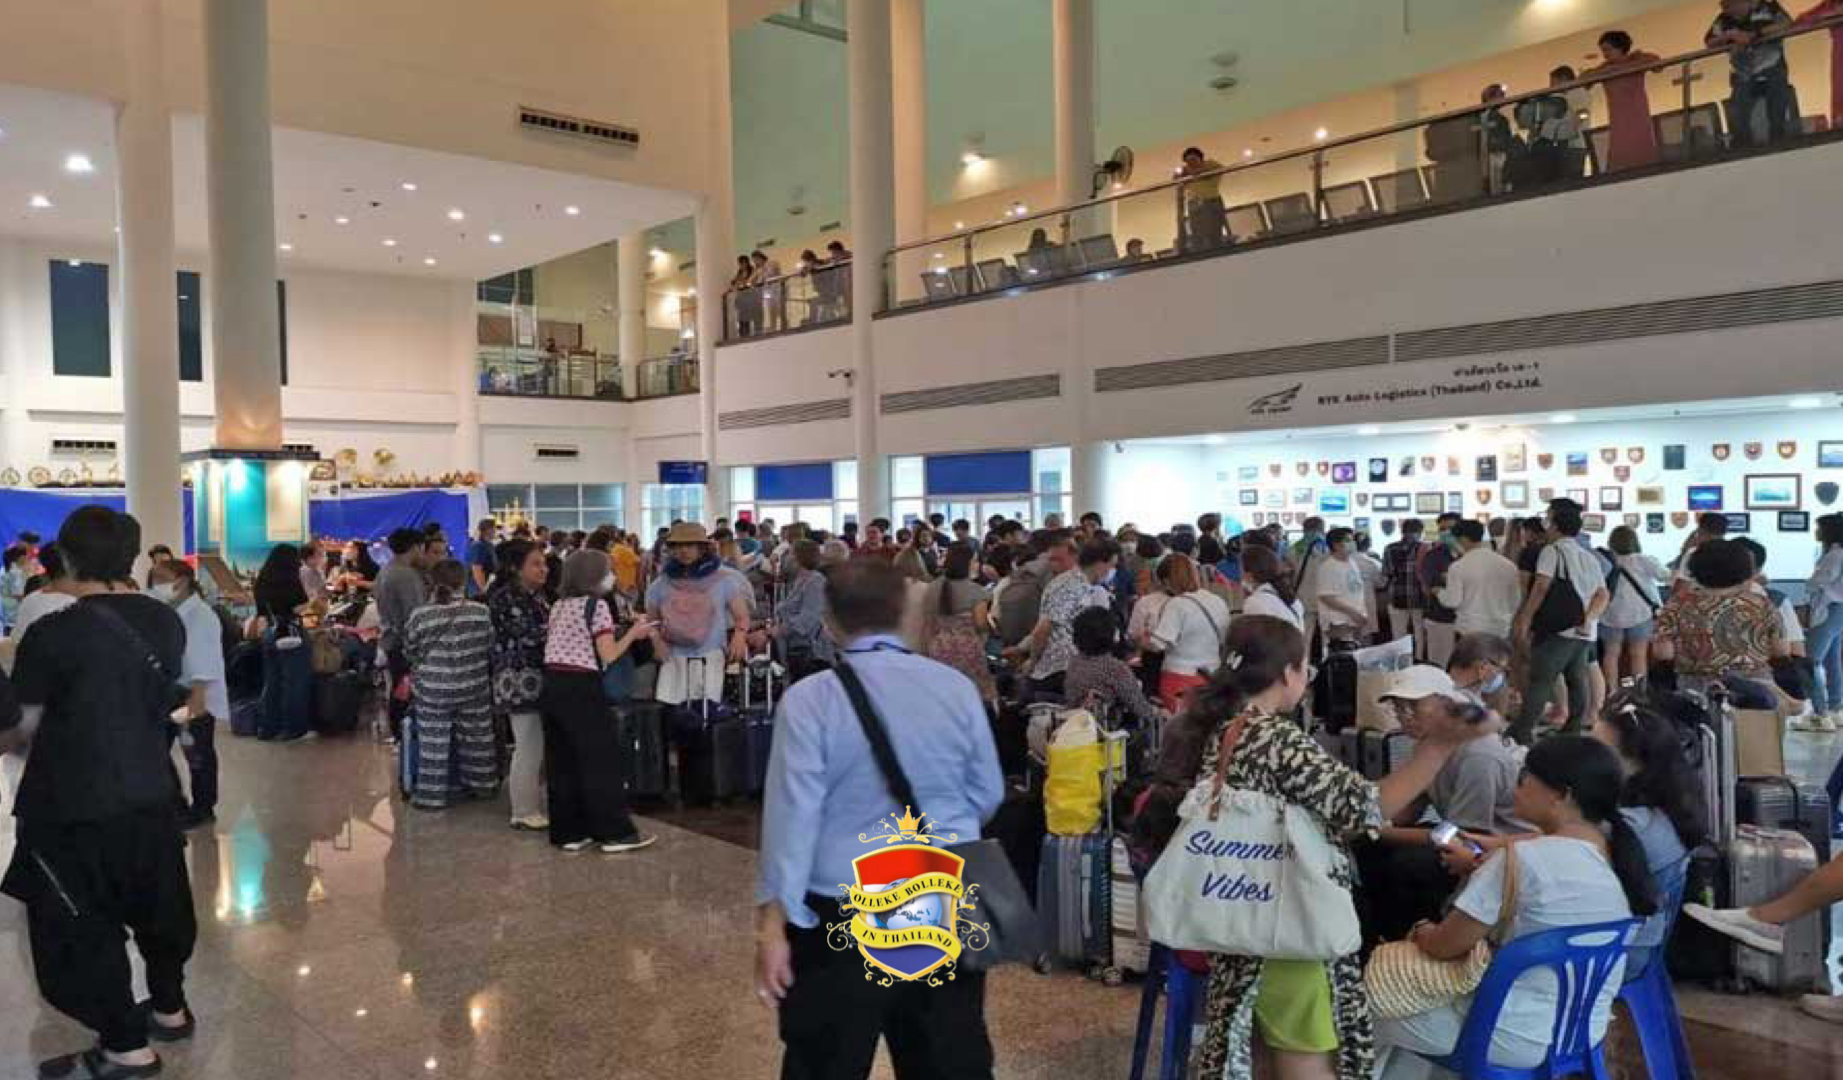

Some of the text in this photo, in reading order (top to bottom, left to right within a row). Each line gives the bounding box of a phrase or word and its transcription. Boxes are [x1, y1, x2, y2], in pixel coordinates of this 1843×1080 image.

[1375, 388, 1427, 401] Logistics
[1431, 380, 1491, 398] (Thailand)
[1201, 871, 1274, 902] Vibes
